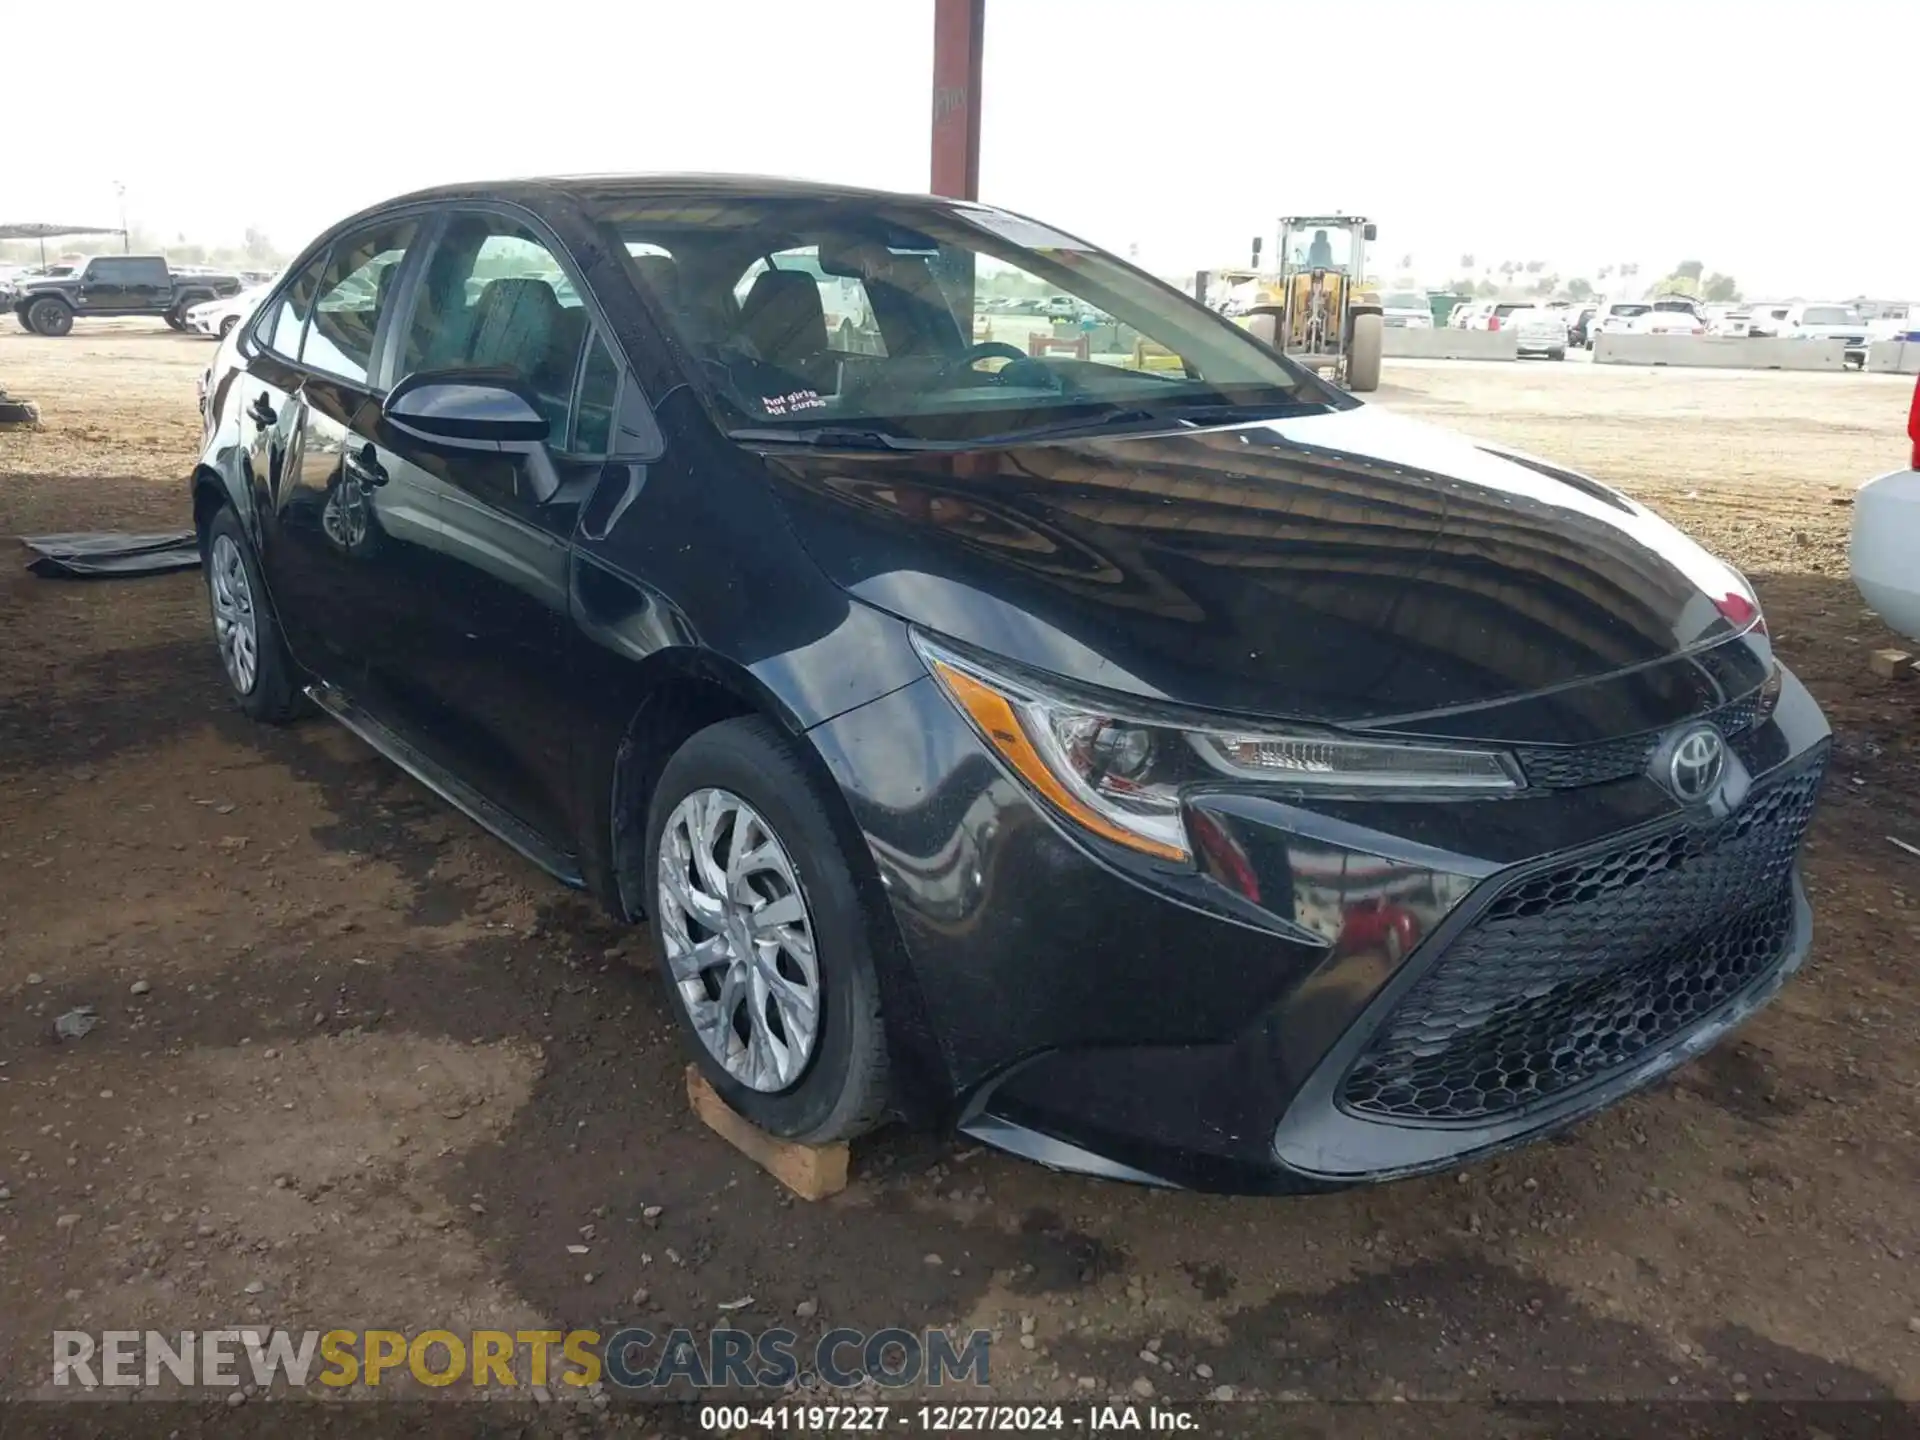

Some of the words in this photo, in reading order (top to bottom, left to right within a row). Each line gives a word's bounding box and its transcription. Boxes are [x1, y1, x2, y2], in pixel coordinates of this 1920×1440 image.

[762, 396, 786, 406] hot
[787, 389, 817, 403] girls
[791, 399, 826, 412] curbs
